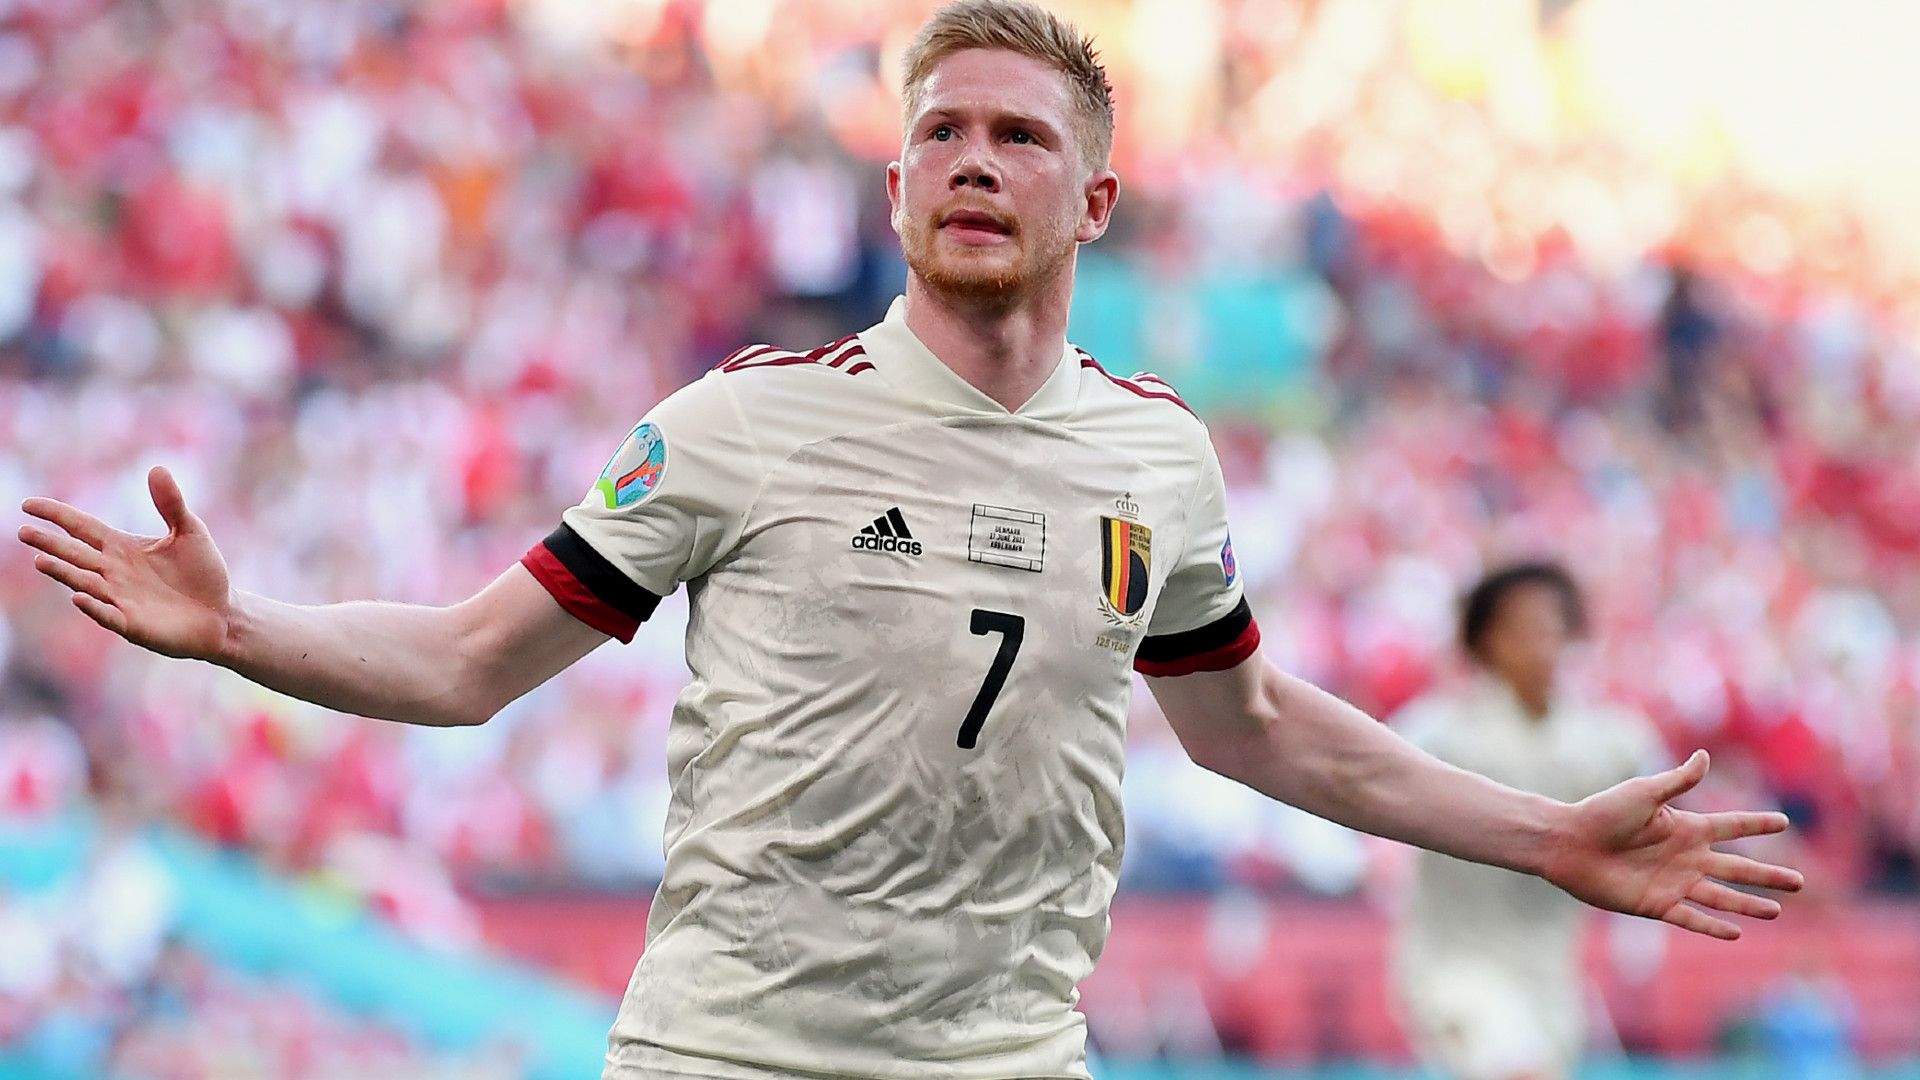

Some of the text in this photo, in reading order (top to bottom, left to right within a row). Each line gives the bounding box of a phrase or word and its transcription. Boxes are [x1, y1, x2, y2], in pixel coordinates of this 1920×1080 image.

[995, 526, 1020, 535] DENMARK
[852, 534, 922, 556] adidas
[1095, 636, 1130, 654] 125 YEARS
[957, 608, 1025, 749] 7
